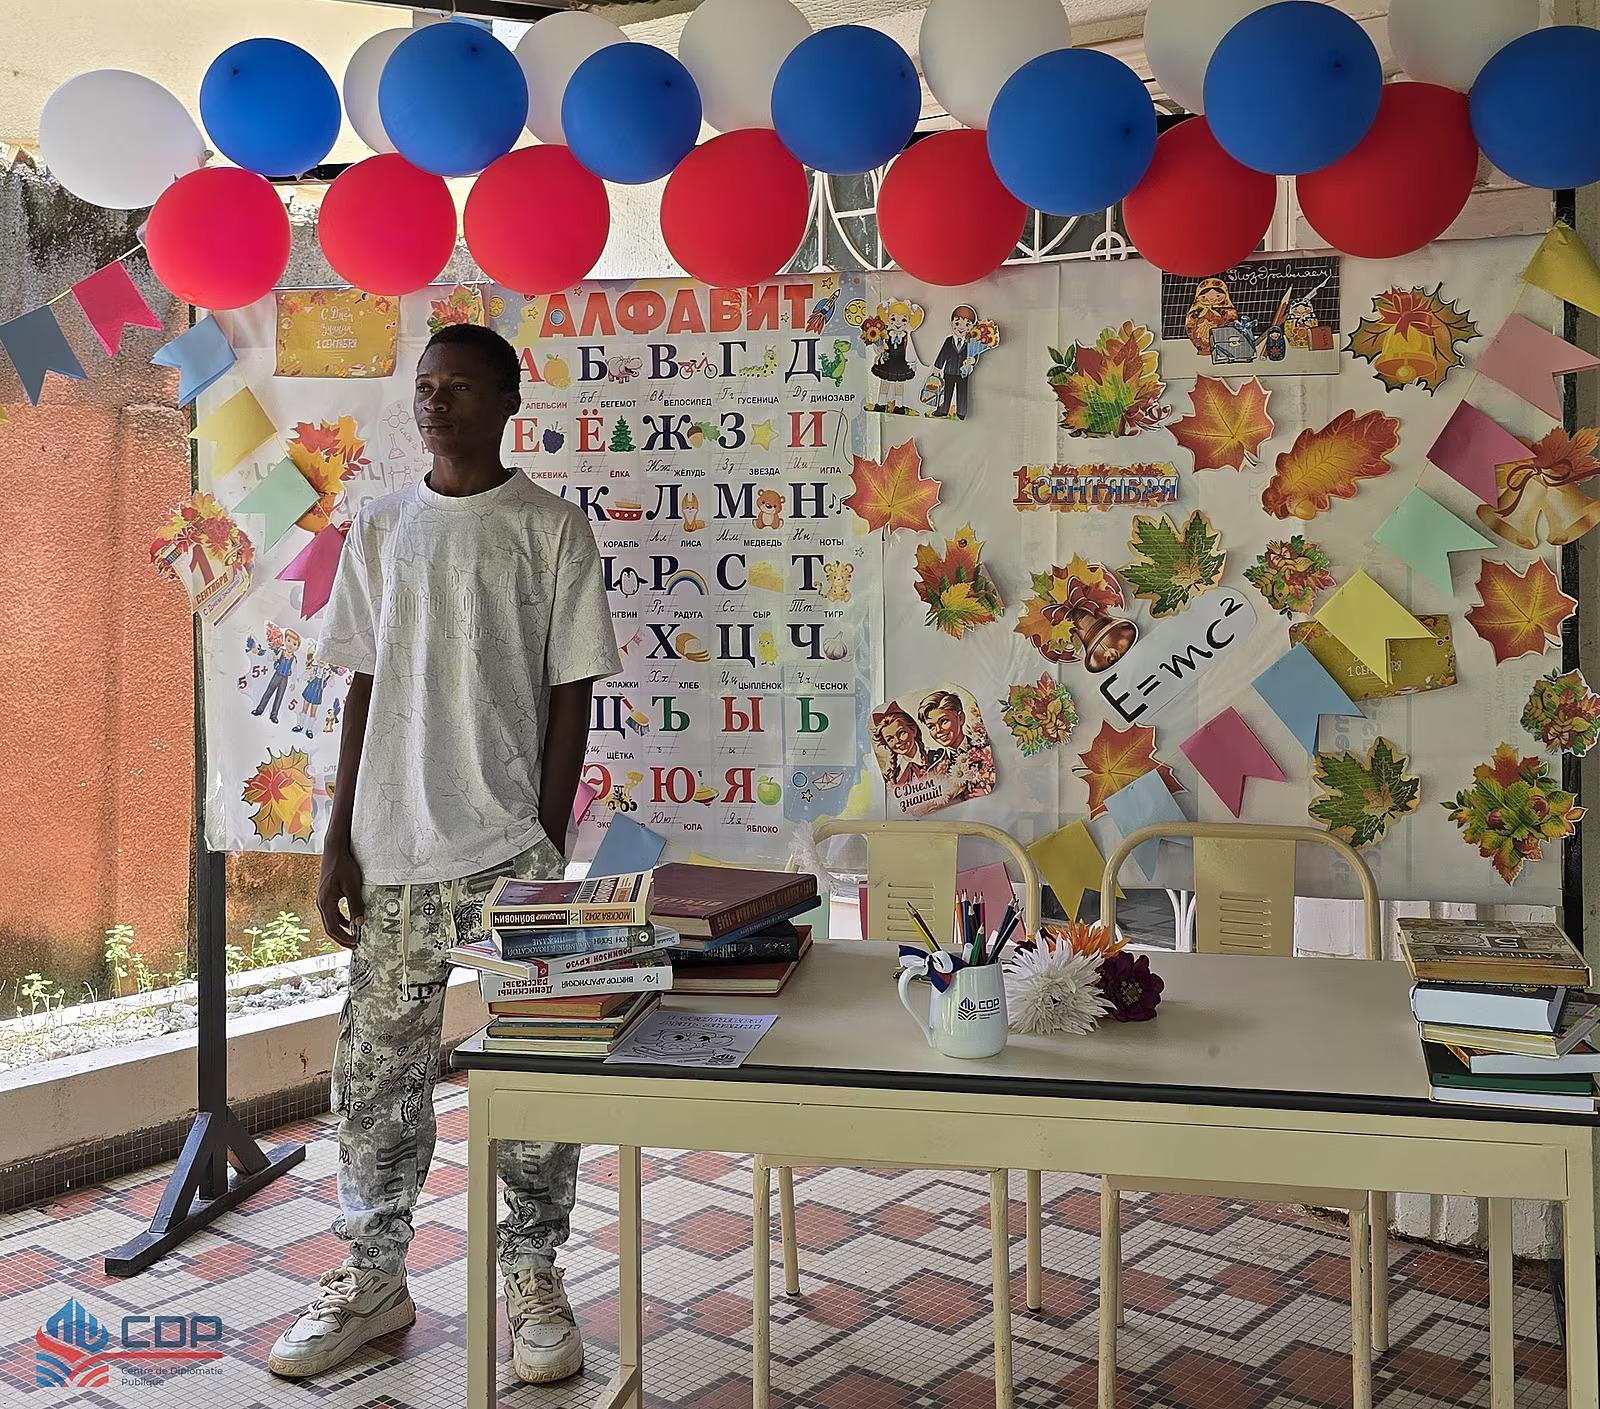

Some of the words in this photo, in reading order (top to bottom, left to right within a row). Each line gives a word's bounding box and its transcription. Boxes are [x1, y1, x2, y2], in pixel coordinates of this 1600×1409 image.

[538, 284, 814, 337] АЛФАВИТ
[519, 347, 545, 382] А
[577, 346, 608, 381] Б
[648, 344, 679, 380] В
[718, 341, 747, 377] Г
[784, 338, 821, 383] Д
[600, 400, 637, 408] БЕГЕМОТ
[664, 398, 712, 407] ВЕЛОСИПЕД
[737, 396, 779, 405] ГУСЕНИЦА
[810, 394, 855, 403] ДИНОЗАВР
[525, 402, 567, 410] АПЕЛЬСИН
[511, 417, 540, 453] Е
[576, 409, 605, 453] Ё
[641, 414, 692, 451] Ж
[718, 411, 746, 449] З
[787, 411, 828, 448] И
[531, 471, 568, 479] ЕЖЕВИКА
[749, 467, 780, 476] ЗВЕЗДА
[820, 466, 841, 474] ИГЛА
[1032, 474, 1178, 505] СЕНТЯБРЯ
[576, 486, 610, 521] К
[646, 484, 682, 520] Л
[713, 483, 757, 519] М
[788, 482, 829, 518] Н
[603, 540, 640, 548] КОРАБЛЬ
[743, 539, 782, 547] МЕДВЕДЬ
[819, 538, 844, 546] НОТЫ
[649, 555, 679, 591] Р
[716, 553, 747, 591] С
[791, 554, 824, 591] Т
[611, 611, 638, 619] НГВИН
[674, 611, 703, 619] РАДУГА
[753, 611, 771, 619] СЫР
[824, 610, 844, 618] ТИГР
[646, 623, 682, 659] Х
[716, 624, 755, 668] Ц
[786, 624, 825, 660] Ч
[252, 665, 268, 678] 5+
[238, 676, 248, 689] 5
[606, 681, 639, 689] ФЛАЖКИ
[678, 681, 700, 689] ХЛЕБ
[815, 682, 849, 690] ЧЕСНОК
[652, 696, 690, 732] Ъ
[721, 696, 765, 733] Ы
[796, 697, 829, 733] Ь
[649, 766, 696, 804] Ю
[720, 767, 757, 804] Я
[894, 785, 903, 799] С
[899, 785, 942, 812] знаний!
[684, 823, 703, 831] ЮЛА
[746, 824, 778, 834] ЯБЛОКО
[494, 913, 536, 924] ВОЙНОВИЧ
[584, 912, 603, 921] 2042
[602, 911, 631, 920] МОСКВА
[1494, 937, 1519, 947] 5
[593, 947, 633, 963] РОБИНЗОН
[565, 955, 592, 969] КРУЗО
[502, 977, 549, 989] рассказы
[561, 979, 606, 989] ДРАГУНСКИЙ
[608, 975, 634, 985] ВИКТОР
[497, 985, 553, 997] Денискины
[979, 998, 1000, 1009] CDP
